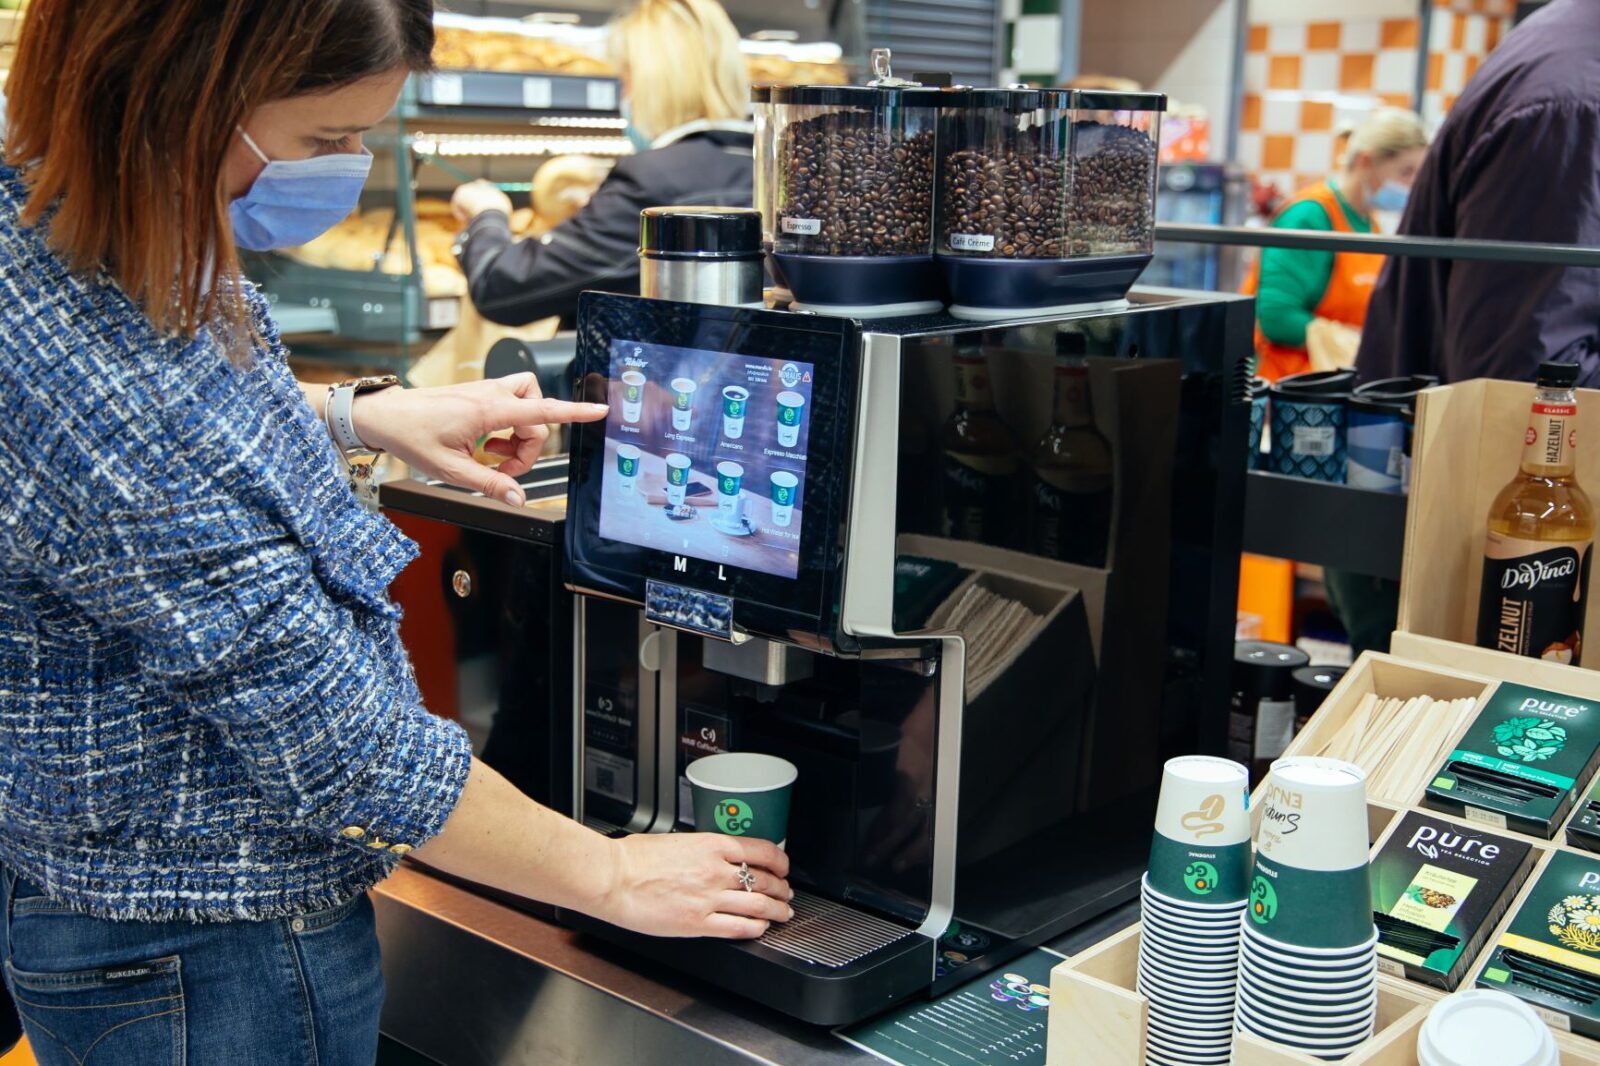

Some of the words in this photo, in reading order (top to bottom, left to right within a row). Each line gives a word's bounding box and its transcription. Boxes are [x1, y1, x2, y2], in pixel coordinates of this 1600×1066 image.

[786, 221, 812, 232] Espresso
[952, 237, 966, 247] Café
[620, 425, 640, 433] Espresso
[664, 432, 676, 440] Long
[676, 433, 695, 442] Espresso
[720, 441, 743, 450] Americano
[1545, 418, 1562, 463] HAZELNUT
[763, 448, 785, 457] Espresso
[674, 555, 687, 572] M
[718, 565, 726, 581] L
[1500, 556, 1575, 590] DaVinci
[1497, 596, 1522, 654] ZELNUT
[1519, 698, 1580, 718] pure
[1267, 783, 1303, 809] ENJO
[719, 803, 739, 816] TO
[726, 817, 752, 832] GO
[1406, 826, 1500, 860] pure
[1440, 848, 1452, 856] TEA
[1453, 853, 1490, 866] SELECTION
[1185, 864, 1208, 877] GO
[1195, 878, 1214, 891] TO
[1252, 879, 1267, 899] GO
[1254, 899, 1271, 922] TO
